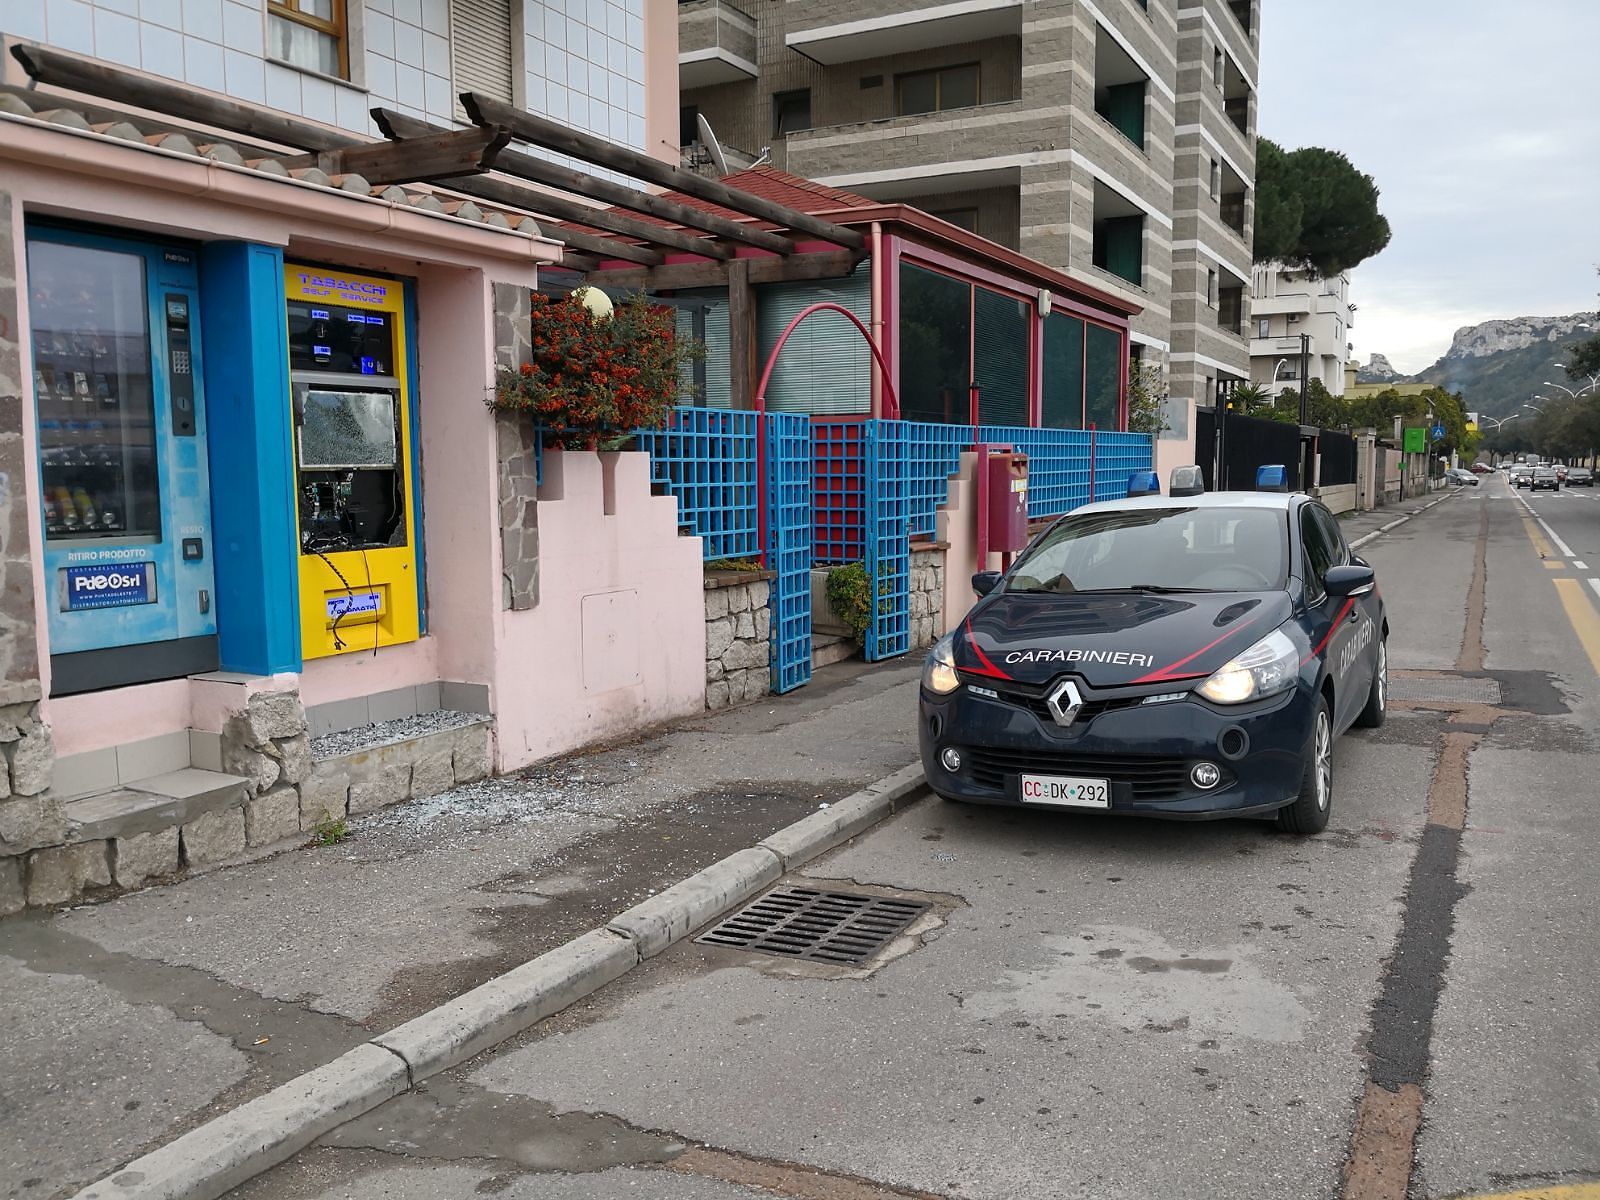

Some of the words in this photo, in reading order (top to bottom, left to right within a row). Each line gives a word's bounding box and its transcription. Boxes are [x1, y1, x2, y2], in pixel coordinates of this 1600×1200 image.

[298, 274, 386, 296] TABACCHI
[302, 287, 330, 296] SELF
[341, 292, 383, 304] SERVICE
[68, 552, 97, 561] RITIRO
[100, 549, 146, 560] PRODOTTO
[1005, 650, 1154, 667] CARABINIERI
[1024, 781, 1042, 797] CC
[1051, 783, 1068, 799] DK
[1077, 785, 1106, 802] 292
